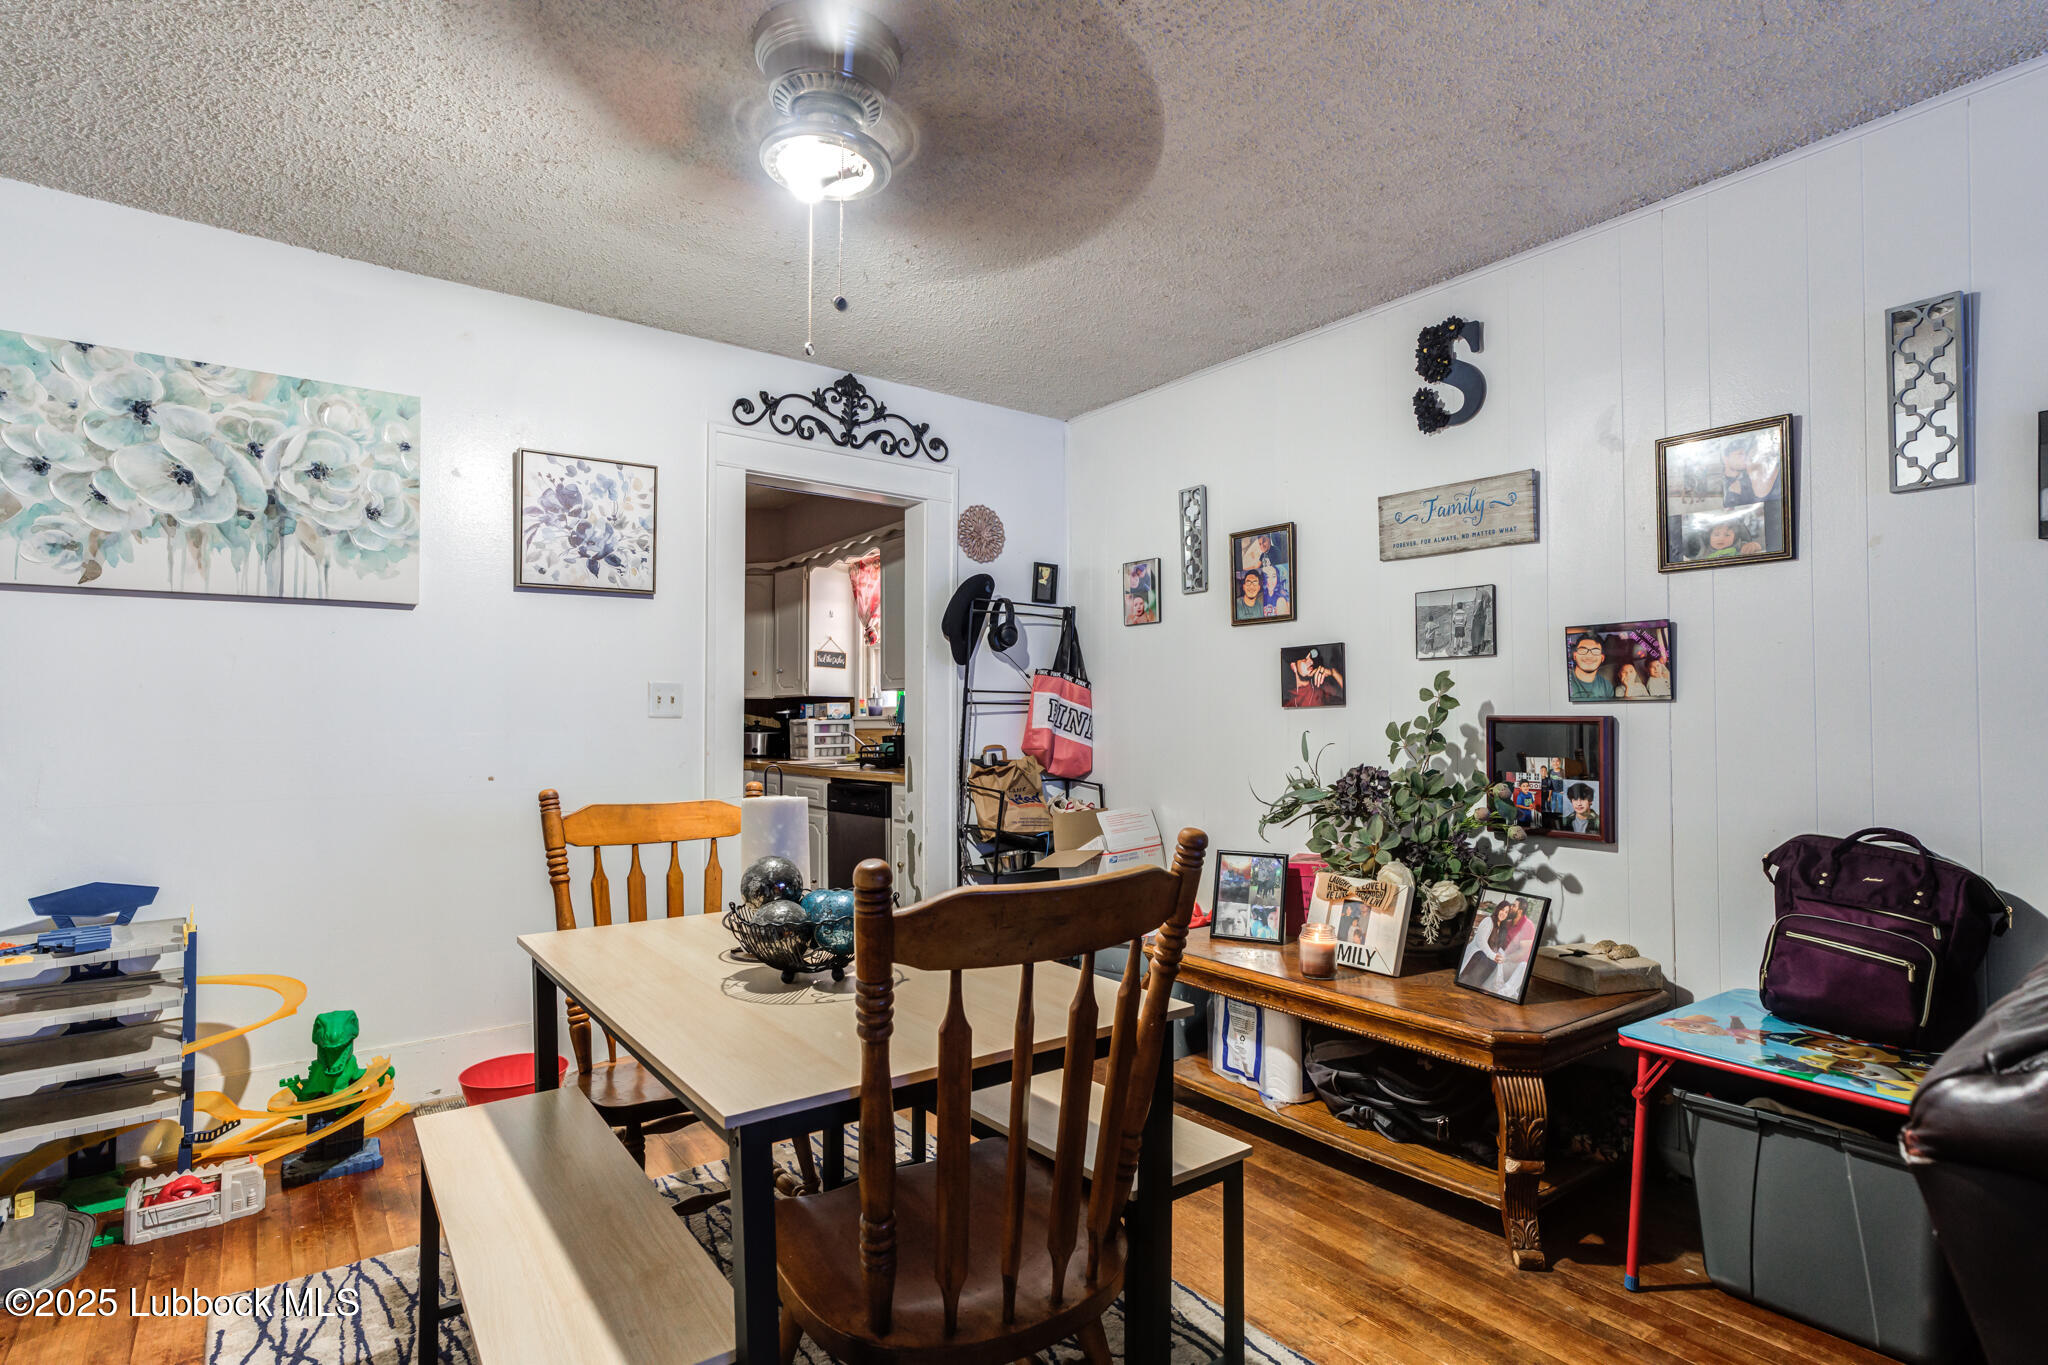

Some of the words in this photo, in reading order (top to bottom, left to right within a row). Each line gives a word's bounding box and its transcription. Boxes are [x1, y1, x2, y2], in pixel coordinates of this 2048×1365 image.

[1421, 487, 1484, 526] Family
[1472, 528, 1496, 538] MATTER
[1499, 525, 1518, 534] WHAT
[1337, 943, 1376, 967] MILY
